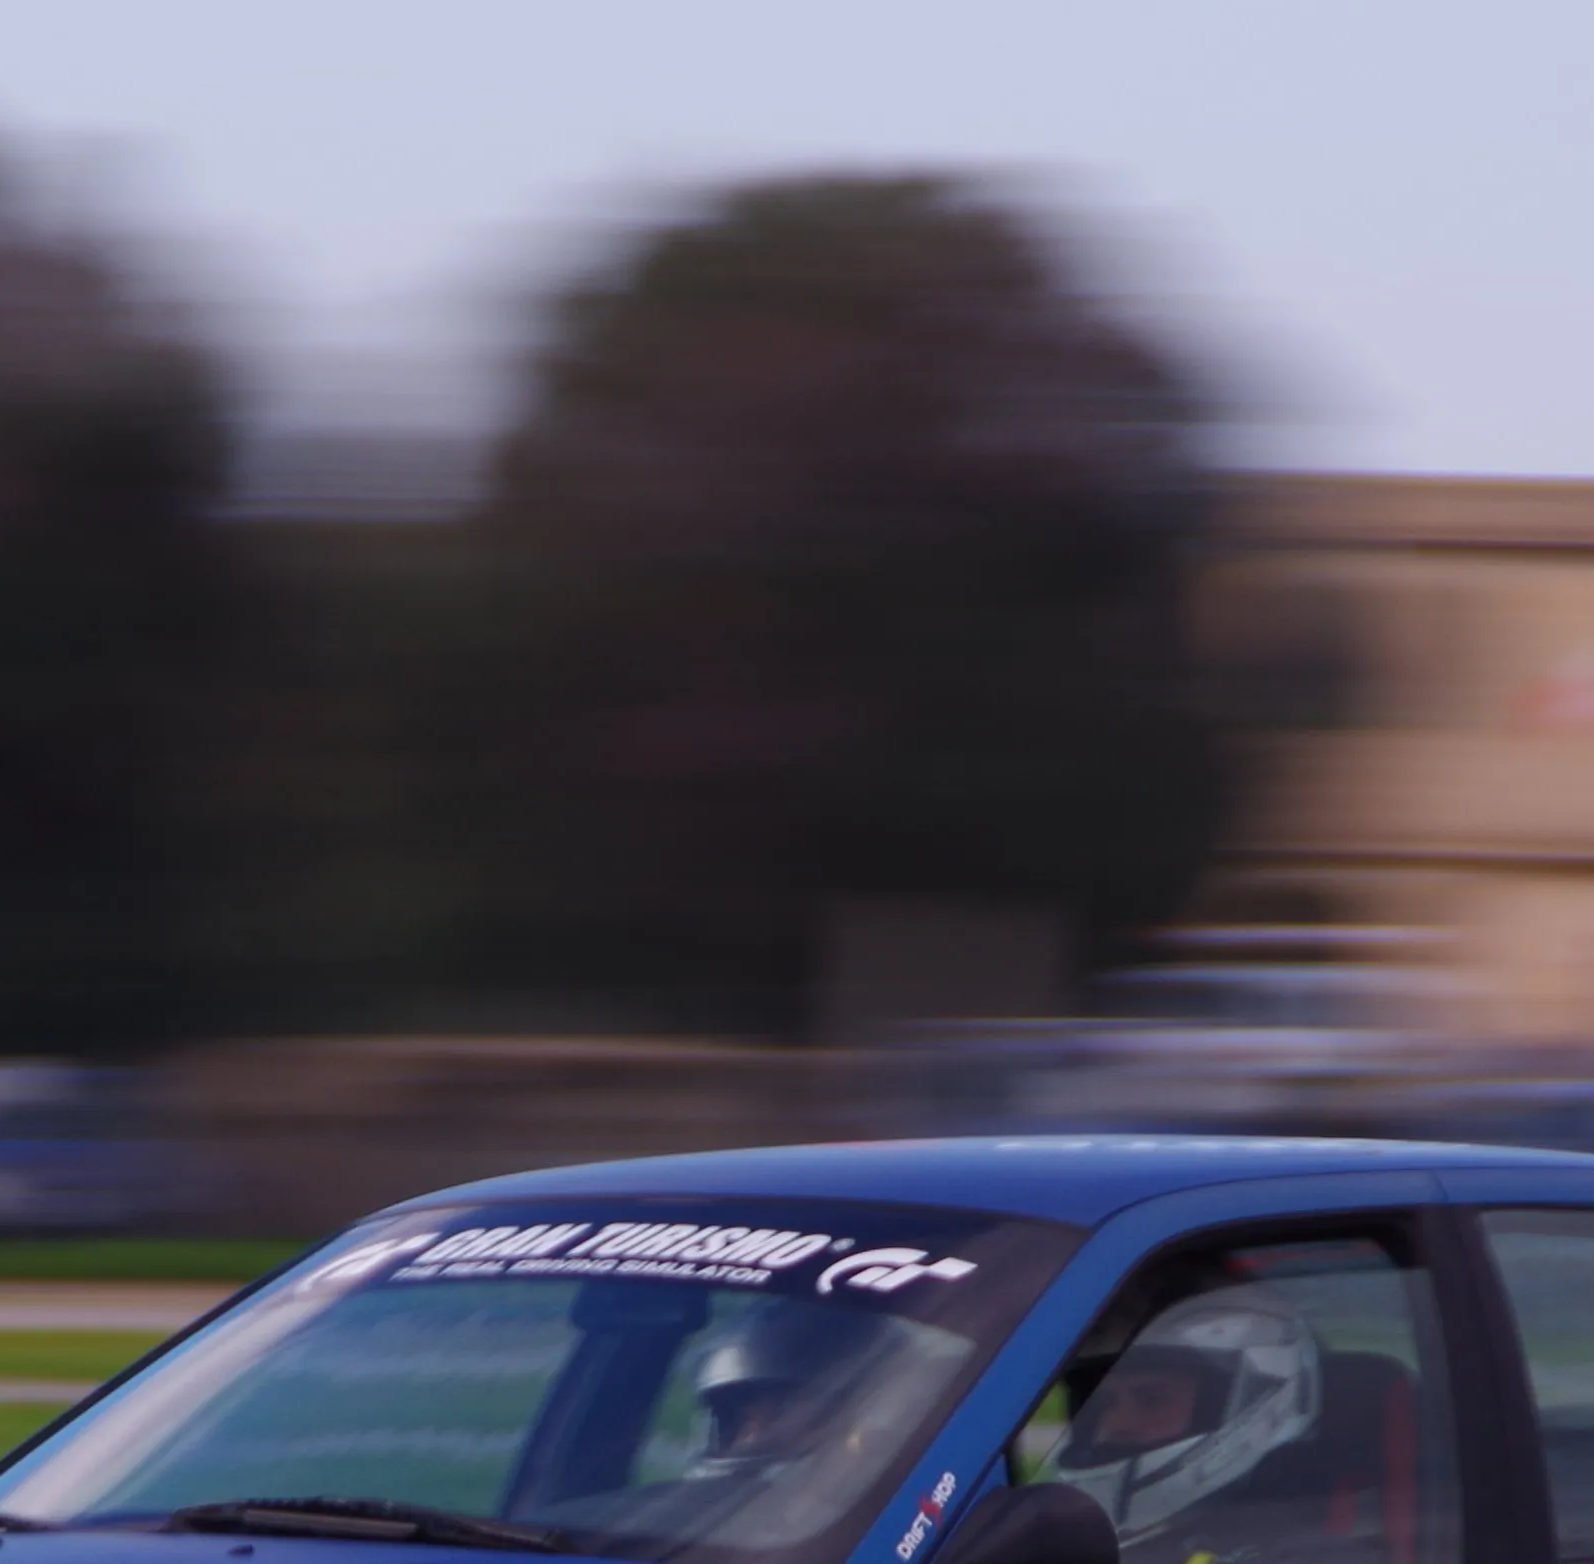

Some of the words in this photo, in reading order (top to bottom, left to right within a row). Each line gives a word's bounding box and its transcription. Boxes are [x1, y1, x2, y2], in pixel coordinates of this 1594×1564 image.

[411, 1221, 594, 1265] GRAN
[565, 1222, 833, 1269] TURISMO
[506, 1258, 620, 1277] DRIVING
[615, 1259, 772, 1284] SIMULATOR
